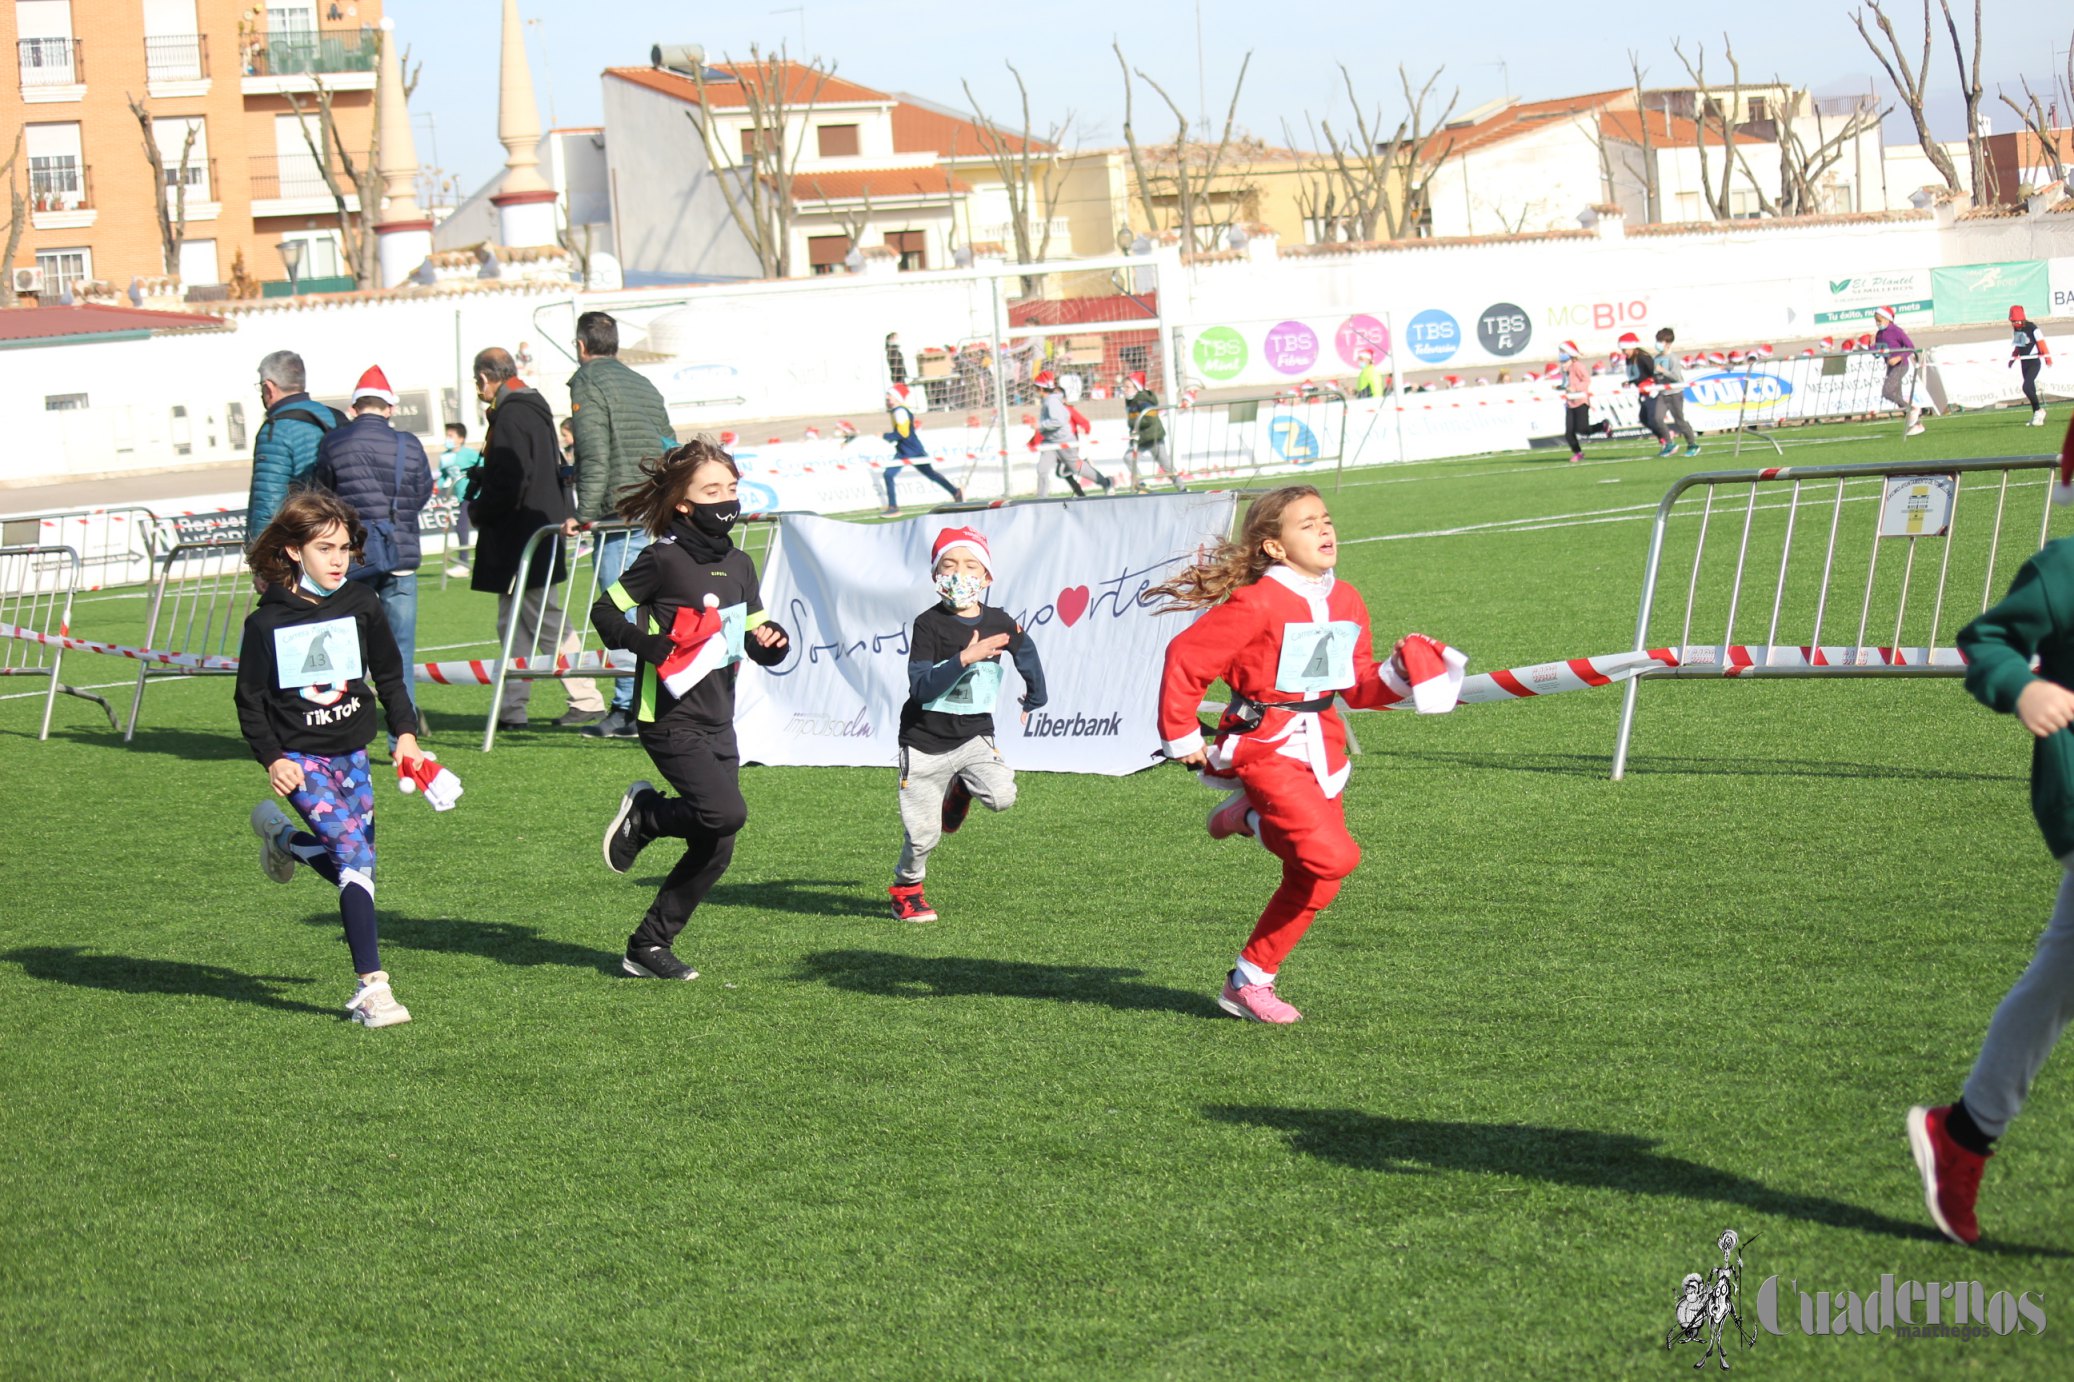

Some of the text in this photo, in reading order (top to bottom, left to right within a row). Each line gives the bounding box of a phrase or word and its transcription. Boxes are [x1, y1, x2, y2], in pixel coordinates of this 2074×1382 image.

[1898, 302, 1920, 312] meta
[1412, 321, 1455, 341] TBS
[1484, 314, 1525, 334] TBS
[1199, 338, 1241, 357] TBS
[1269, 333, 1312, 352] TBS
[763, 598, 911, 677] Somos
[310, 653, 327, 668] 13
[1316, 657, 1324, 671] 7
[1023, 711, 1123, 738] Liberbank
